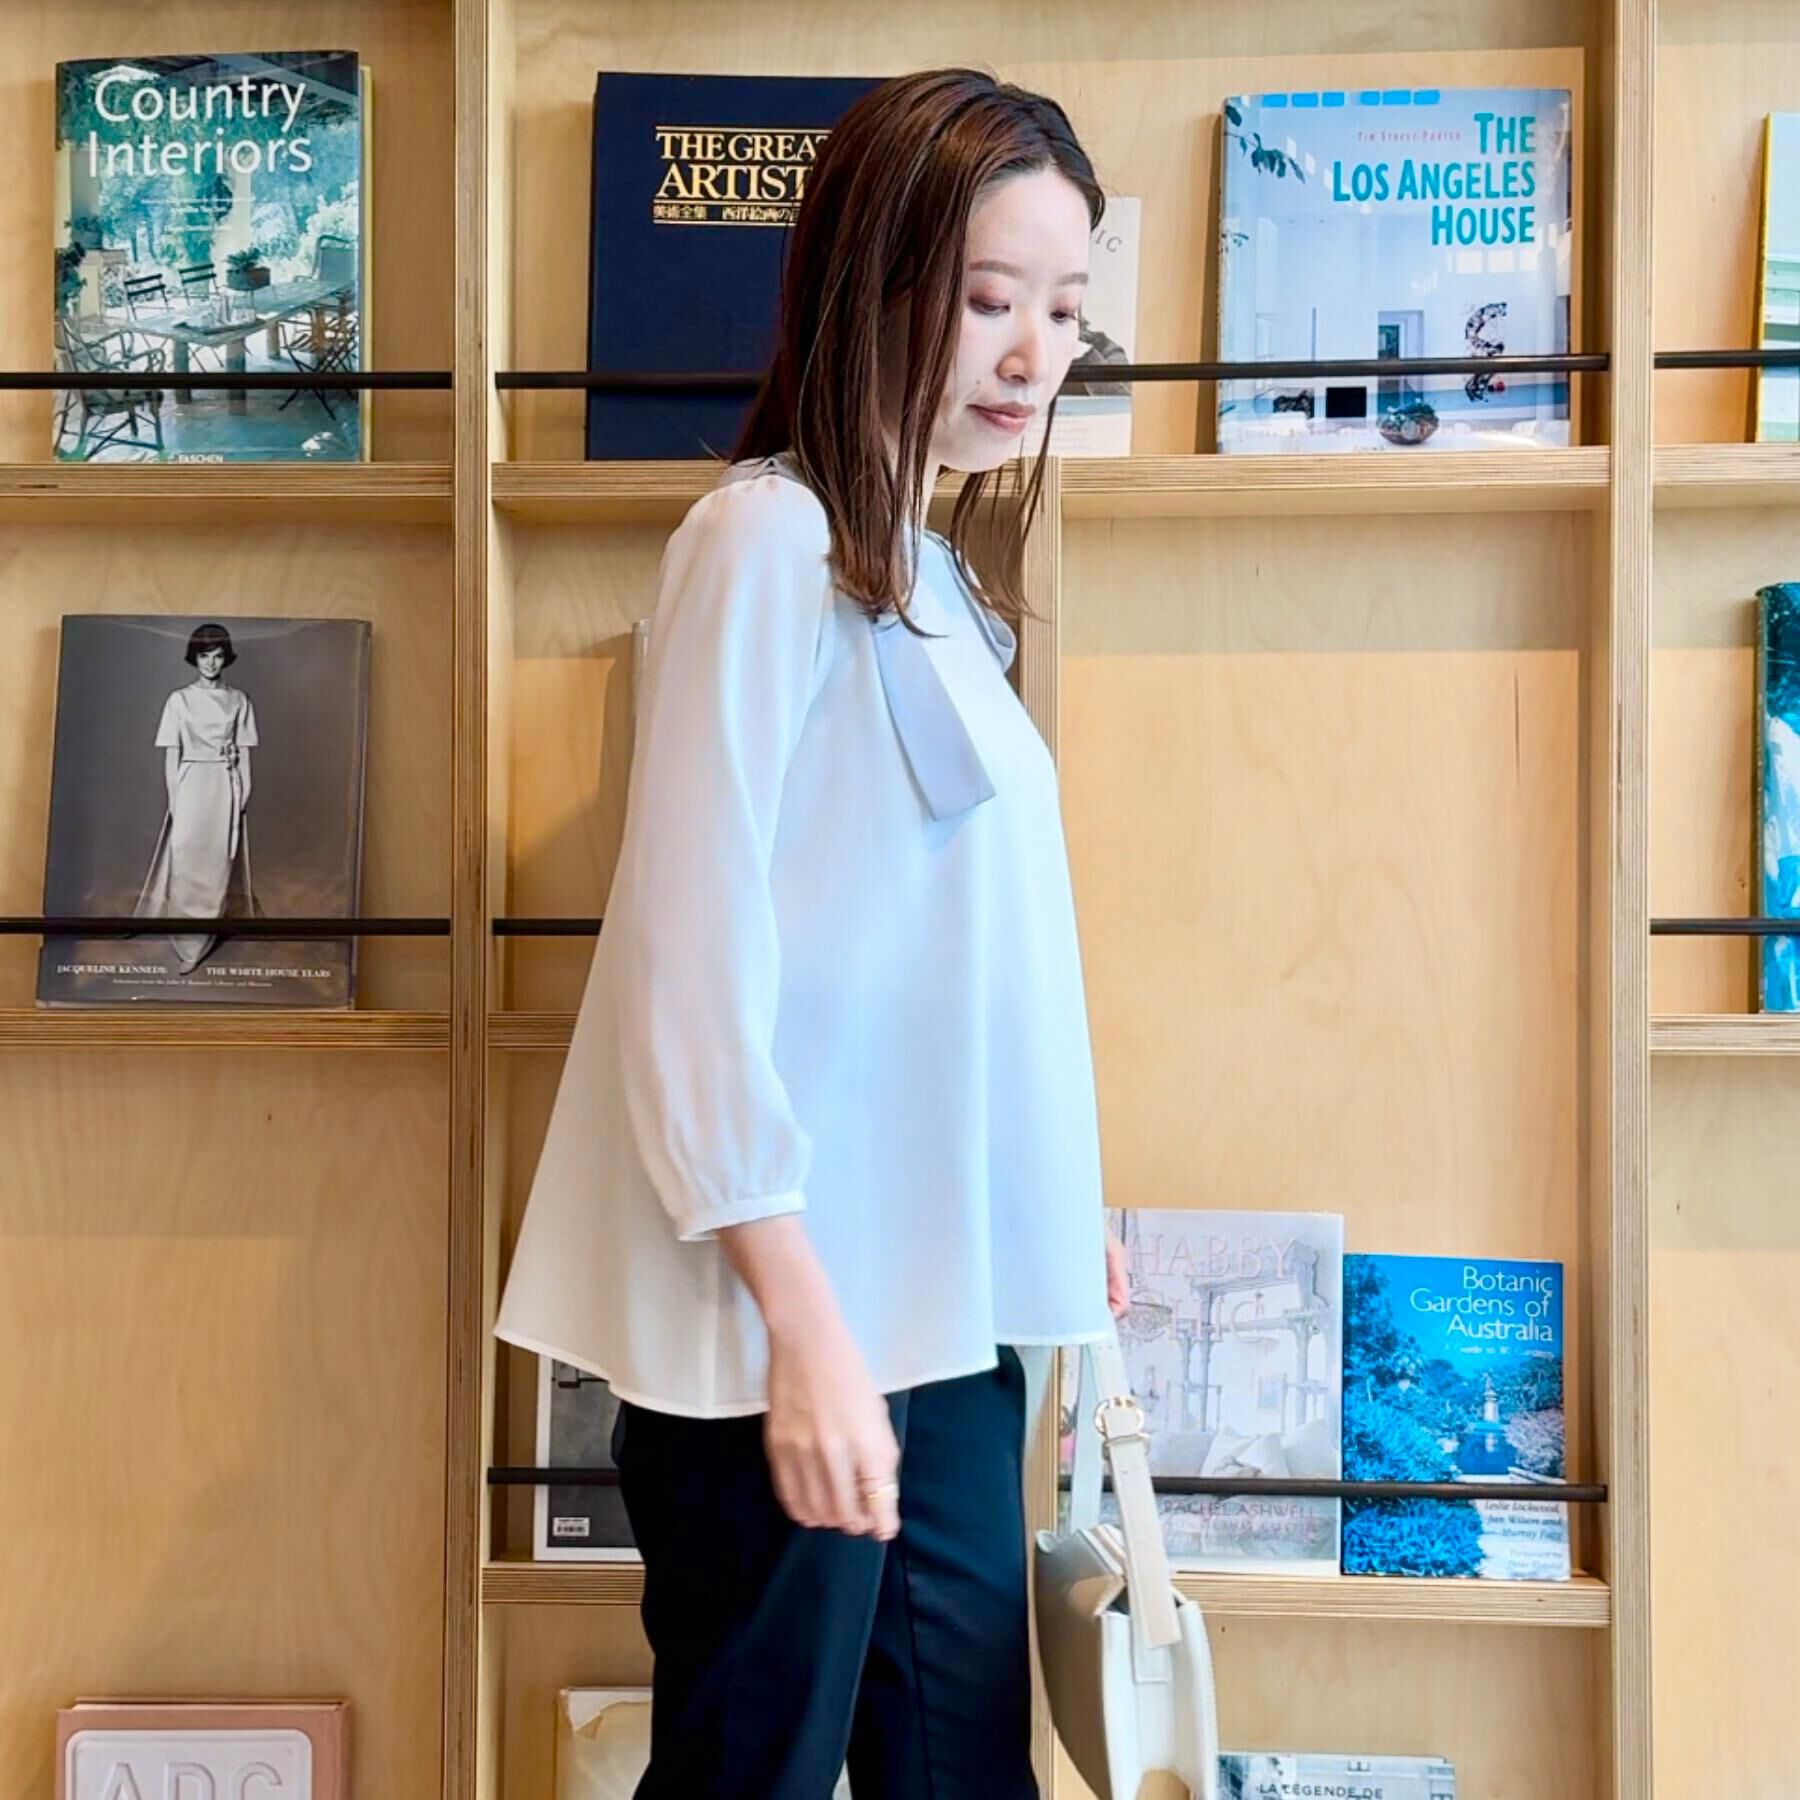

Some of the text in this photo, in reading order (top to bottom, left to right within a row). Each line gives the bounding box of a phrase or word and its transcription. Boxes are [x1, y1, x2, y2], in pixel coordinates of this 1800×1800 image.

[95, 73, 306, 133] Country
[655, 132, 726, 160] THE
[1474, 112, 1536, 155] THE
[89, 127, 313, 178] Interiors
[1333, 159, 1536, 201] LOS ANGELES
[1431, 205, 1536, 246] HOUSE
[1095, 229, 1123, 253] IC
[206, 967, 227, 976] THE
[229, 967, 263, 976] WHITE
[302, 969, 332, 978] YEARS
[1128, 1233, 1297, 1280] HABBY
[1463, 1265, 1553, 1293] Botanic
[1409, 1287, 1553, 1318] Gardens of
[1446, 1313, 1554, 1342] Australia
[1165, 1501, 1315, 1518] RACHEL ASHWELL
[1259, 1783, 1278, 1794] LA
[1362, 1786, 1383, 1799] DE
